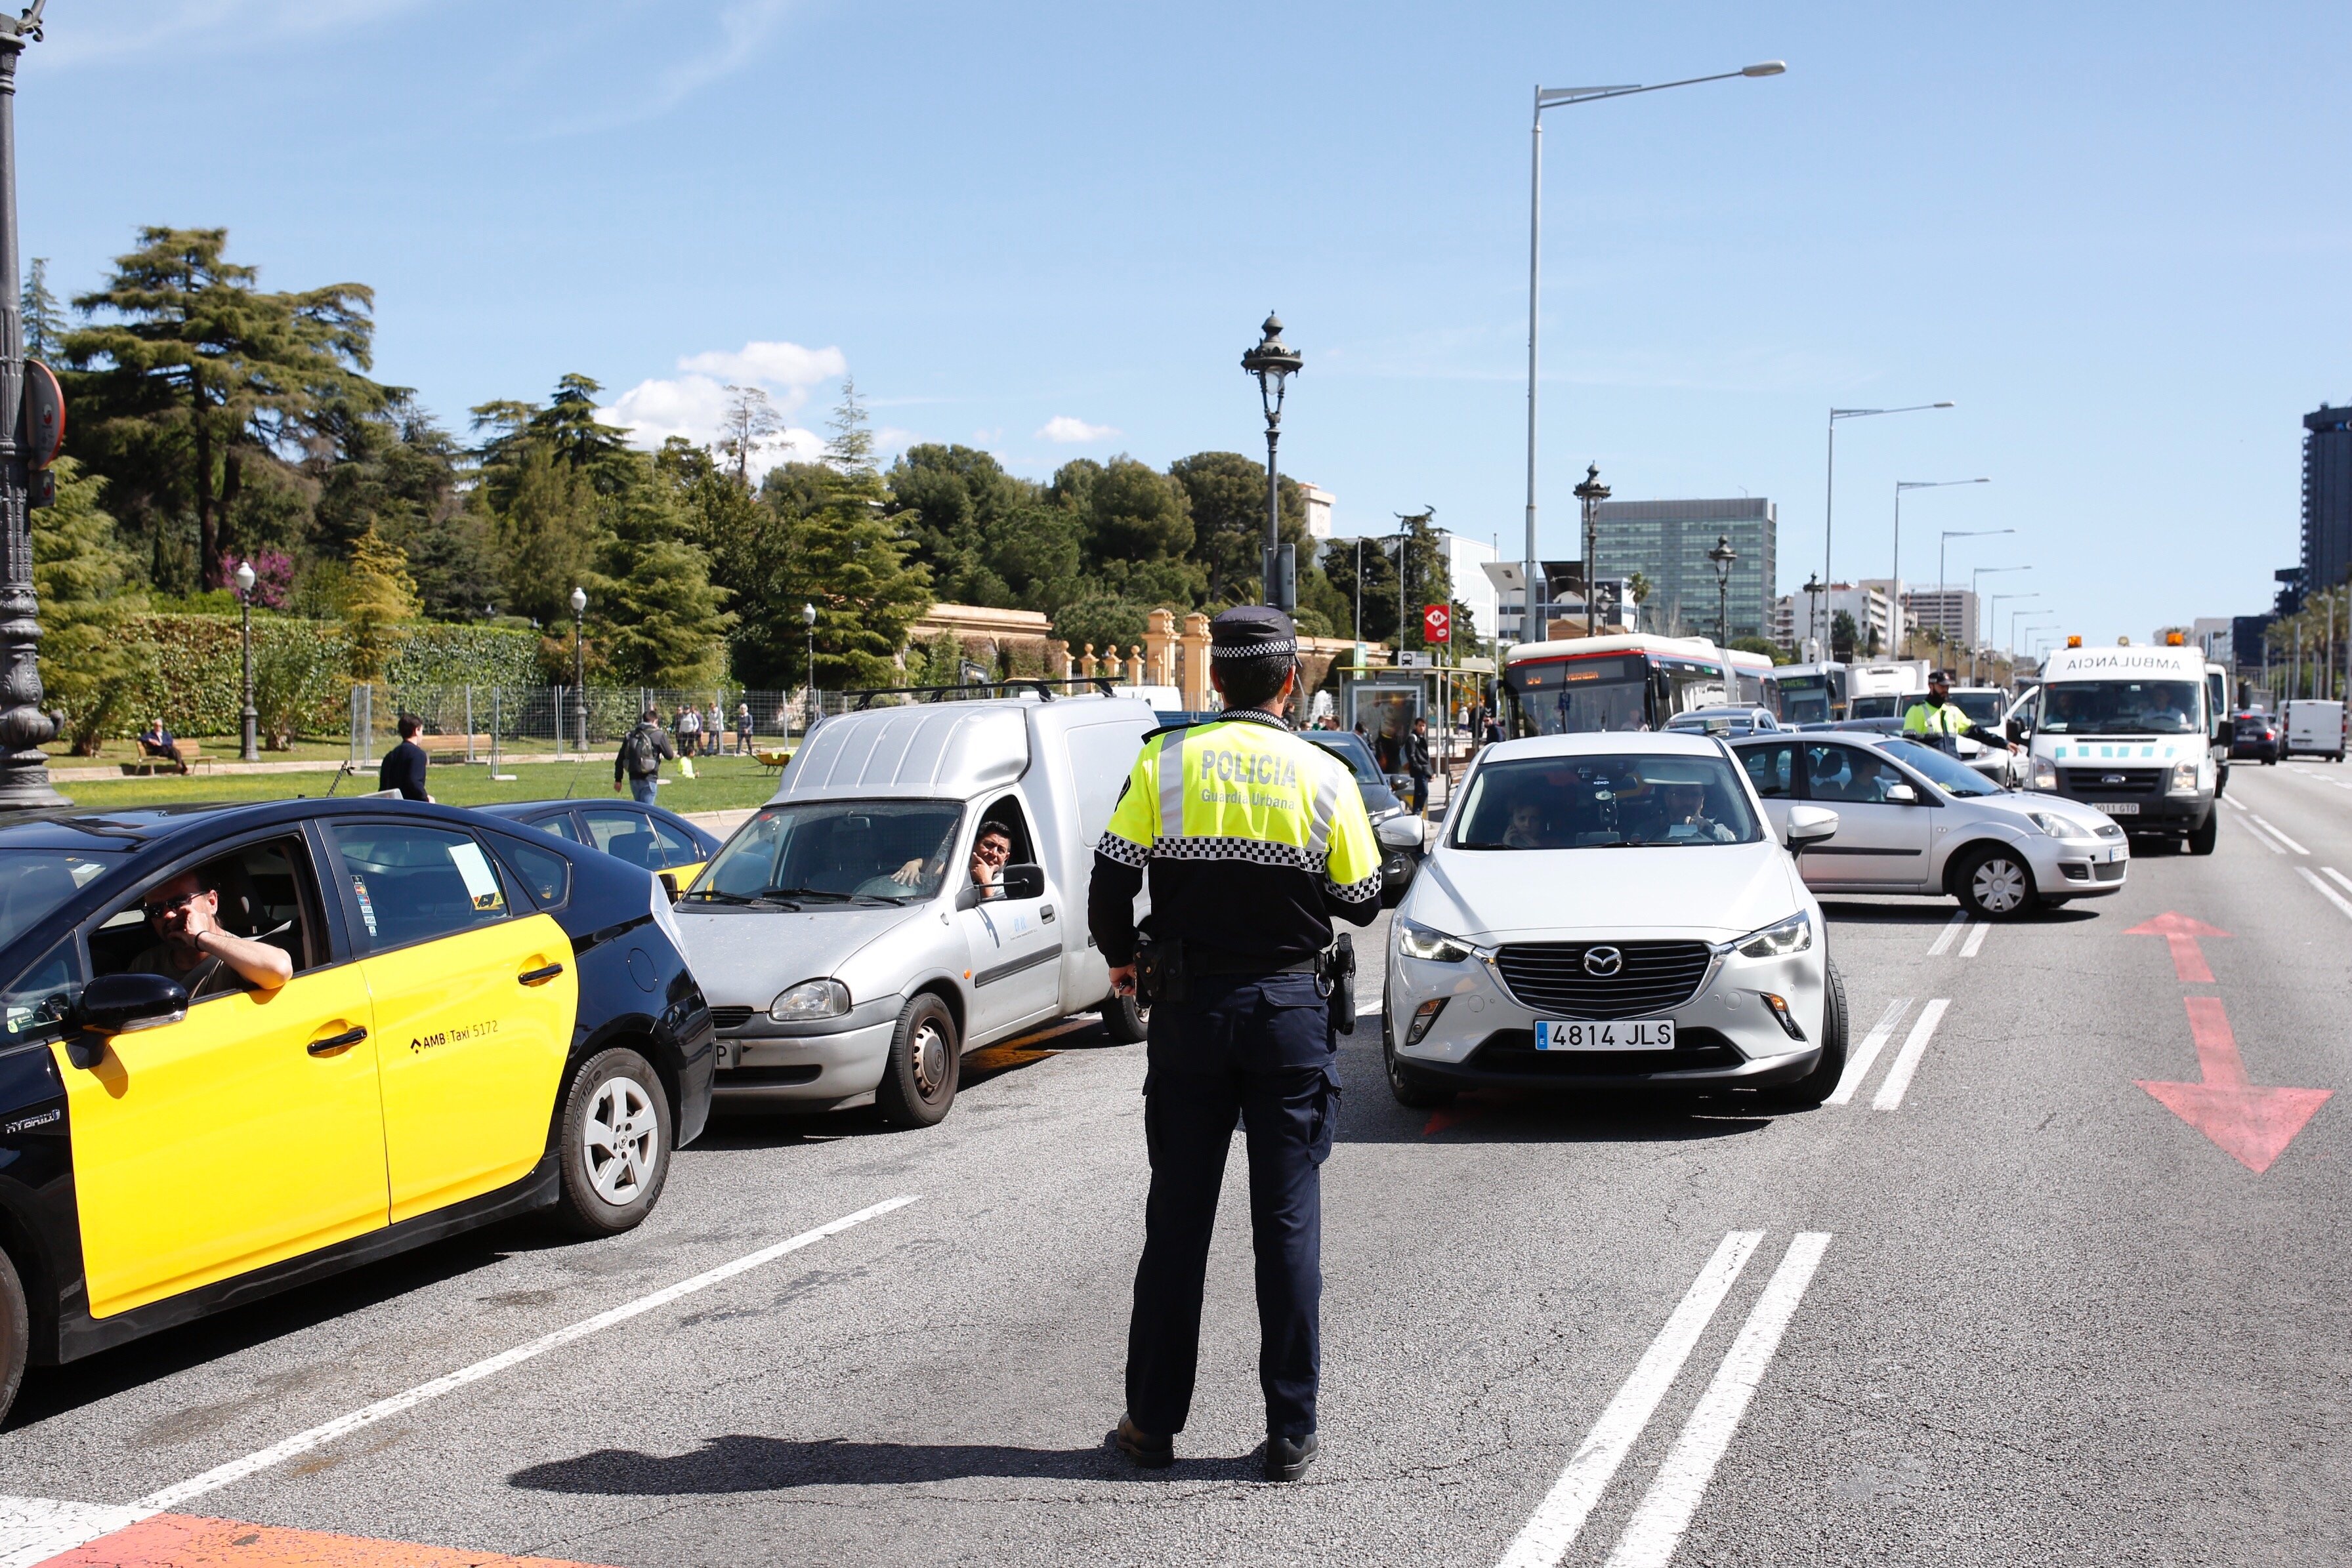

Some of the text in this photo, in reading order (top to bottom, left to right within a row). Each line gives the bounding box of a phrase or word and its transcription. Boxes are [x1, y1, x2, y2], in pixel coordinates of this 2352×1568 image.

[1202, 750, 1296, 789] POLICIA
[1251, 792, 1295, 810] Urbana
[424, 1020, 498, 1049] AMB Taxi 5172
[1553, 1024, 1671, 1046] 4814 JLS
[716, 1044, 727, 1065] P
